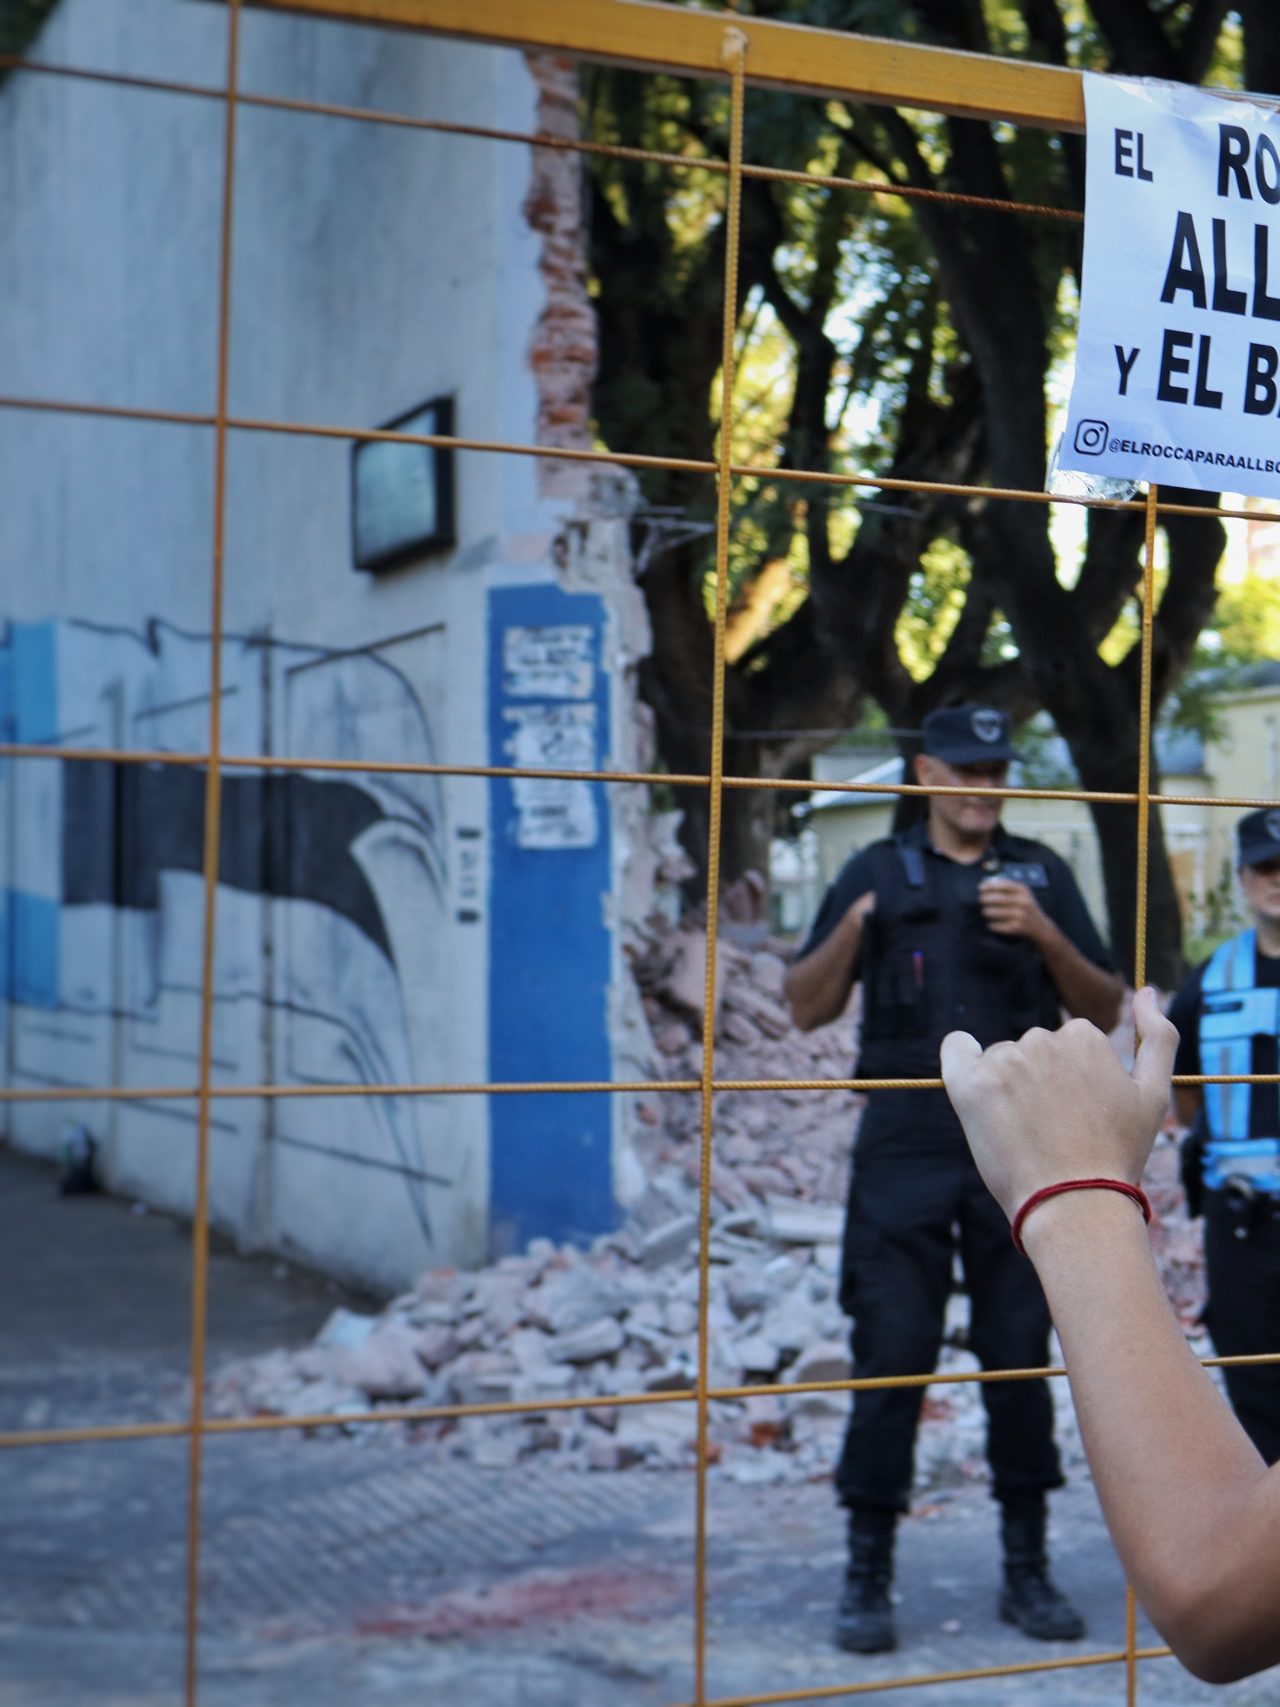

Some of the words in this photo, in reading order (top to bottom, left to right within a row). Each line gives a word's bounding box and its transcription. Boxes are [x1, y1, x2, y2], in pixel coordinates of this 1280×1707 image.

[1114, 127, 1154, 182] EL
[1113, 344, 1141, 397] Y
[1156, 328, 1224, 410] EL
